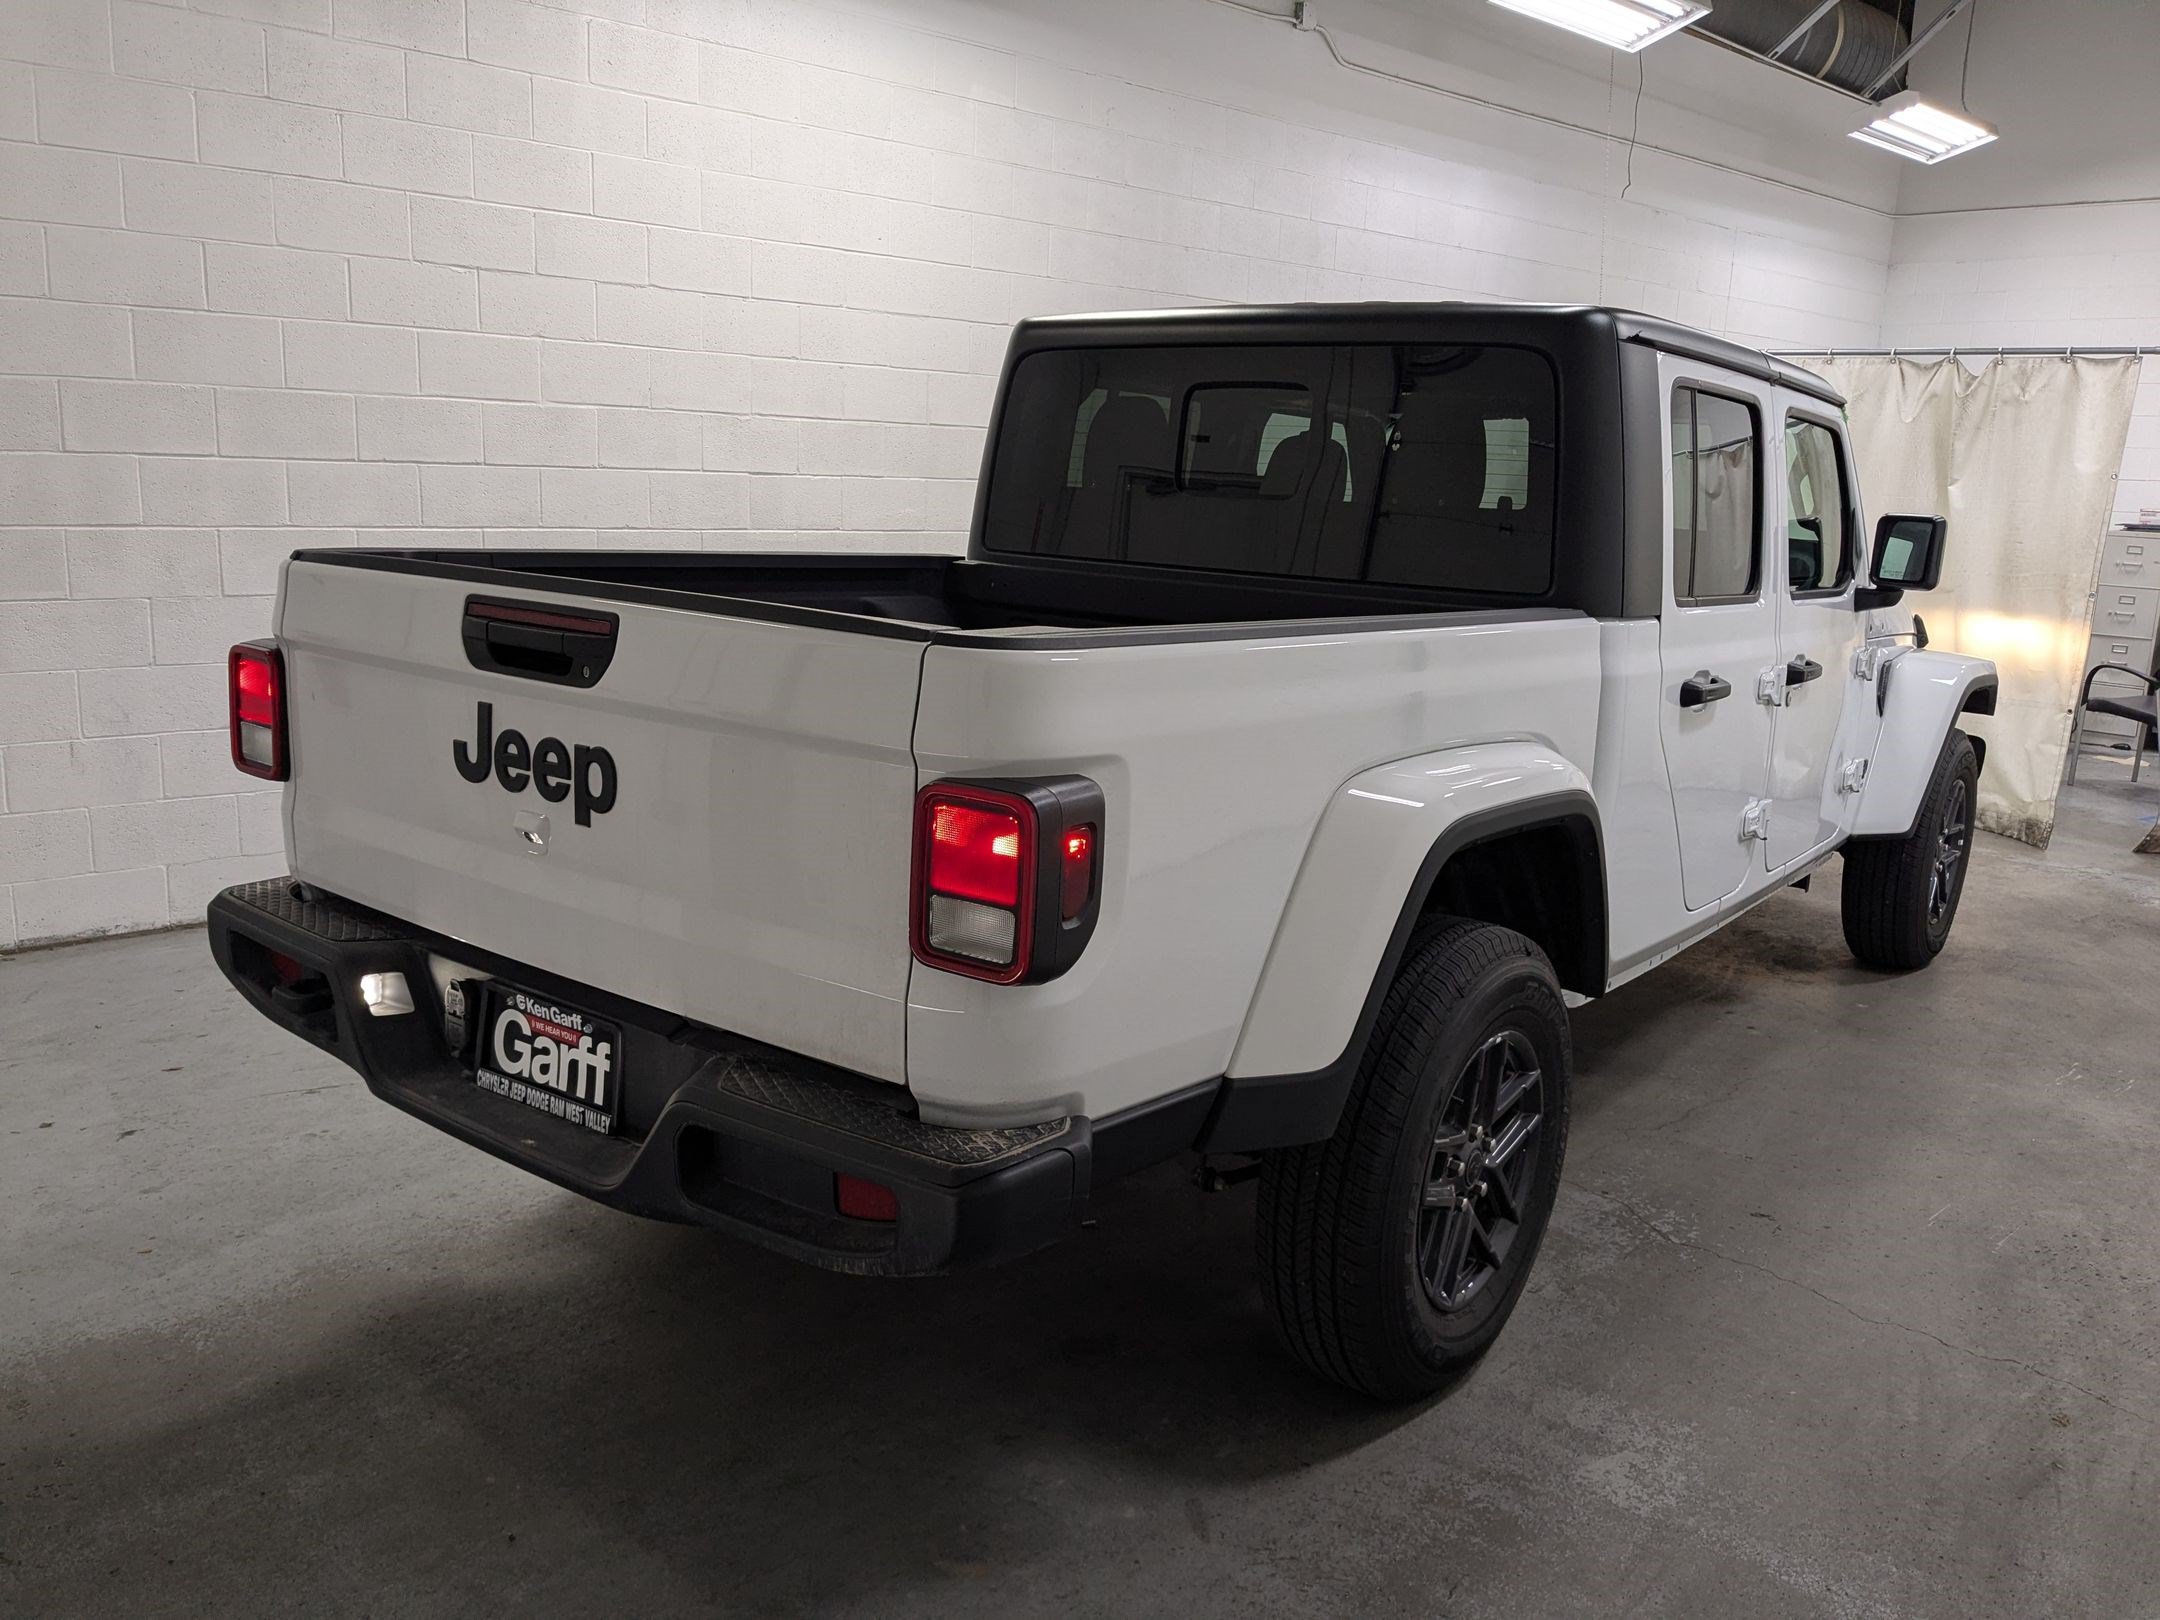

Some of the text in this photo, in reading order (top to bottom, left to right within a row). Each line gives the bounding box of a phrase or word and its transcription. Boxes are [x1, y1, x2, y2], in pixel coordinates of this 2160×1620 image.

[453, 702, 617, 828] Jeep
[494, 1009, 611, 1106] Garff
[536, 1021, 573, 1041] WE HEAR YOU
[477, 1070, 611, 1134] CHRYSLER JEEP DODGE RAM WEST VALLEY
